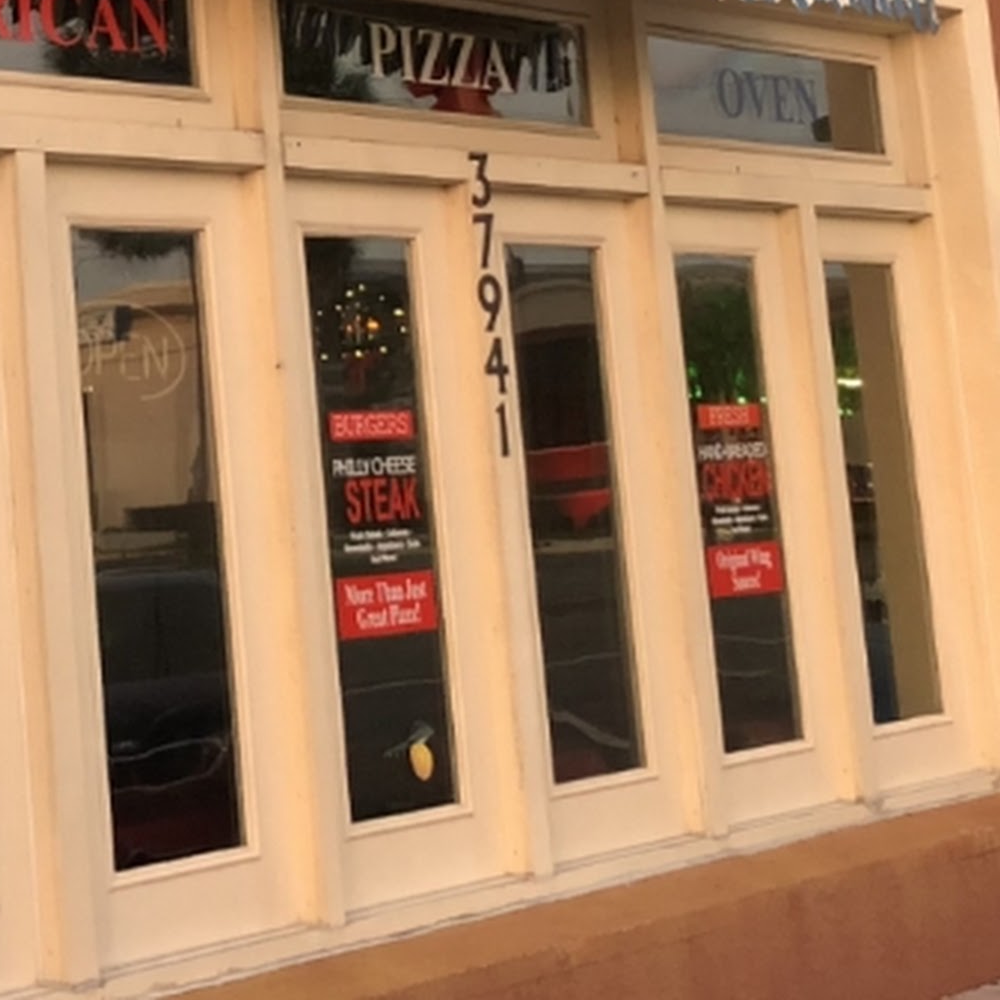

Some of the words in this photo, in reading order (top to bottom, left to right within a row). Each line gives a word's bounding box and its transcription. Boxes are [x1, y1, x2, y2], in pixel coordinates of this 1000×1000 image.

[367, 21, 515, 94] PIZZA
[716, 67, 821, 125] OVEN
[467, 151, 510, 458] 37941
[332, 411, 411, 437] BURGERS
[371, 455, 416, 475] CHEESE
[344, 476, 421, 525] STEAK
